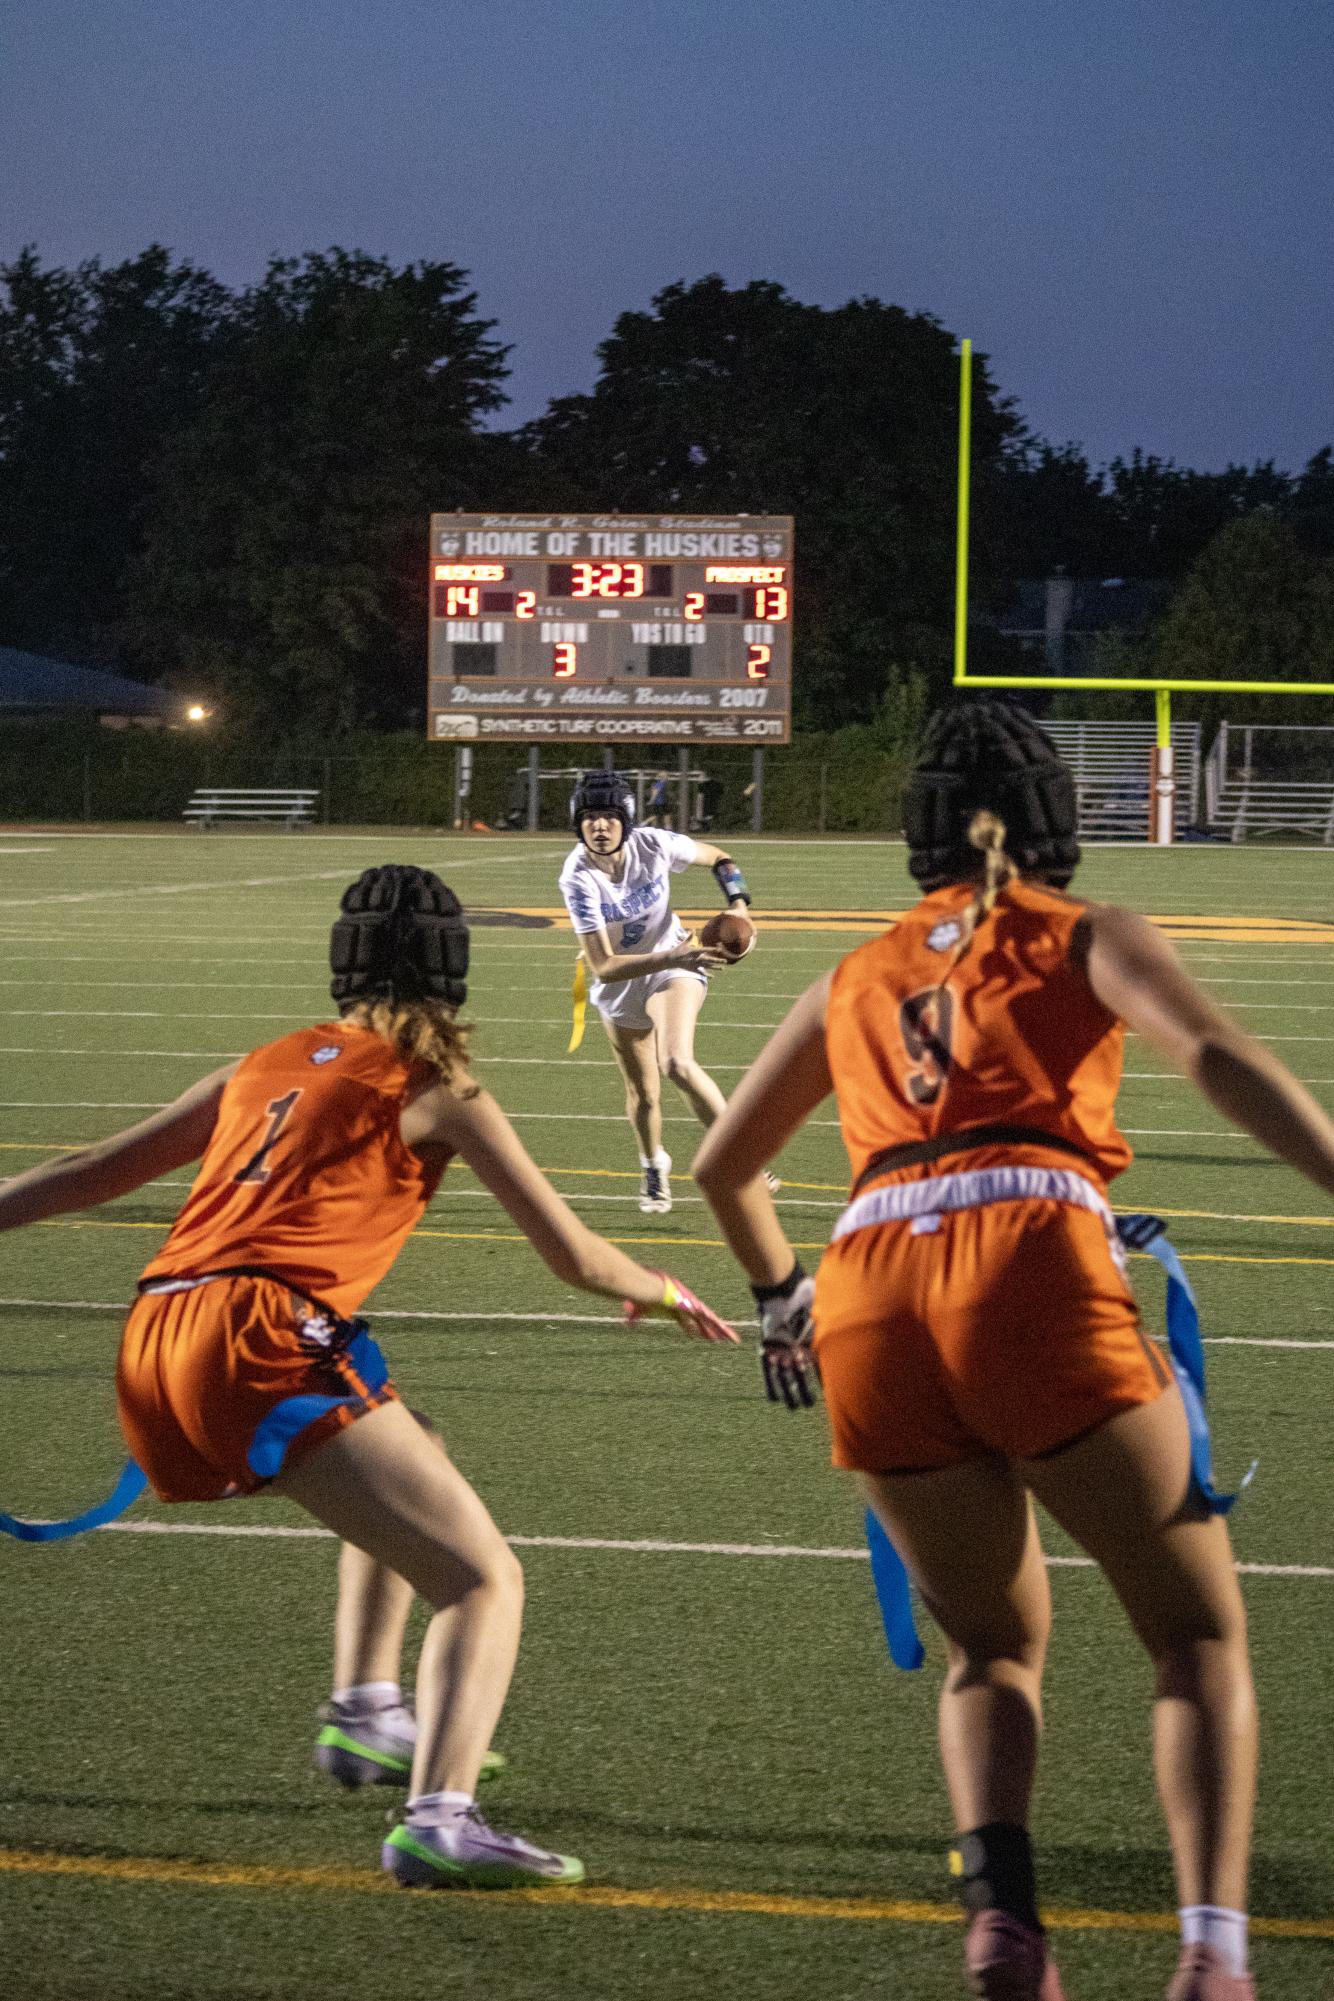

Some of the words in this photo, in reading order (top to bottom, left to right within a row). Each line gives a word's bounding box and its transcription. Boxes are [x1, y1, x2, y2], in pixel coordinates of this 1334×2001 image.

[465, 532, 540, 556] HOME
[547, 532, 580, 556] OF
[588, 532, 637, 556] THE
[645, 533, 760, 557] HUSKIES
[571, 563, 644, 597] 3:23
[447, 586, 479, 616] 14
[516, 591, 536, 618] 2
[685, 593, 704, 620] 2
[756, 586, 787, 621] 13
[555, 643, 576, 677] 3
[747, 645, 771, 678] 2
[533, 688, 554, 707] by
[719, 688, 769, 707] 2007
[233, 1087, 304, 1186] 1
